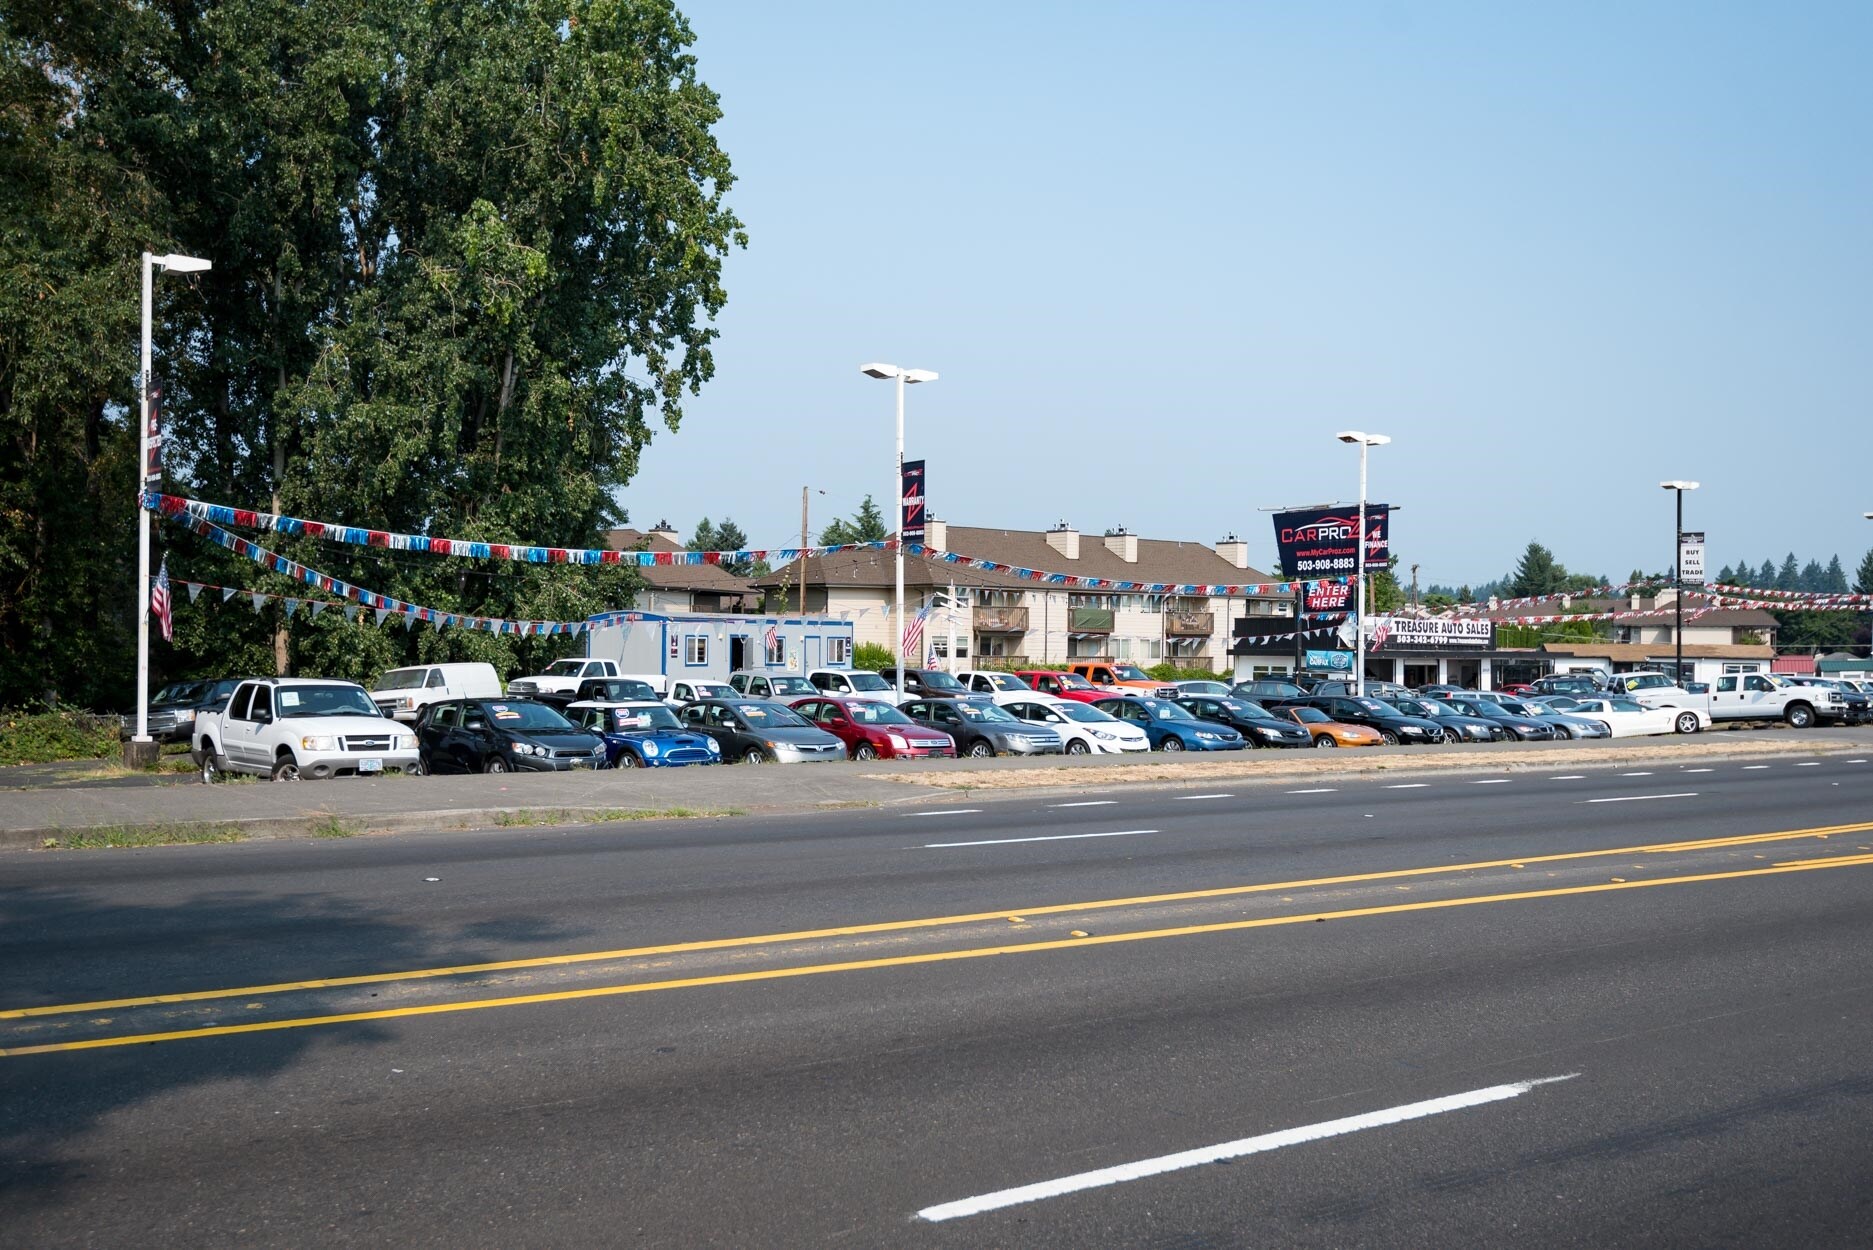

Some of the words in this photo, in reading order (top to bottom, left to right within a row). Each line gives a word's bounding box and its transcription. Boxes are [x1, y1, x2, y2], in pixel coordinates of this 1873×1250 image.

[1371, 531, 1381, 539] WE
[1365, 540, 1388, 548] FINANCE
[1297, 558, 1354, 571] 503-908-8883
[1308, 585, 1349, 597] ENTER
[1311, 596, 1346, 608] HERE
[1395, 620, 1438, 634] TREASURE
[1441, 622, 1464, 634] AUTO
[1466, 622, 1489, 635] SALES
[1397, 635, 1448, 644] 503-342-6799
